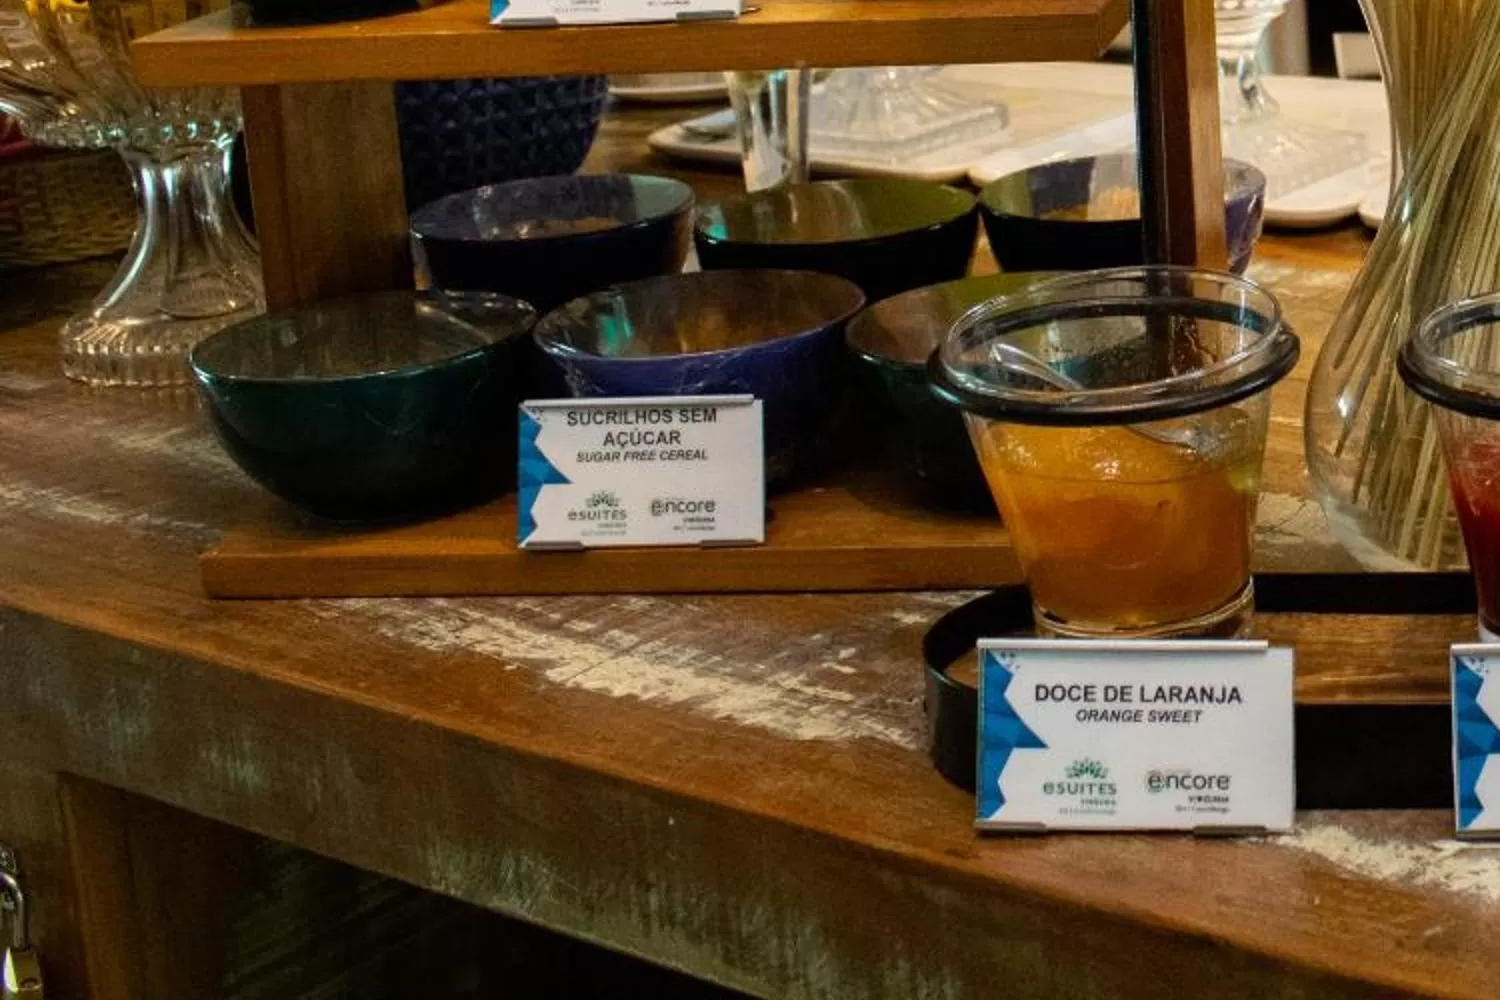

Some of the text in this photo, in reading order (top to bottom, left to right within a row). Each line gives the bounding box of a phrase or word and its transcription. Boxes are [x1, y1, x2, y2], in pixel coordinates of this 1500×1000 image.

[567, 408, 717, 427] SUCRILHOS SEM
[603, 428, 681, 448] AÇÚCAR
[576, 449, 708, 463] SUGAR FREE CEREAL
[651, 499, 716, 517] encore
[1034, 684, 1243, 704] DOCE DE LARANJA
[1076, 709, 1204, 723] ORANGE SWEET
[1146, 770, 1231, 793] encore
